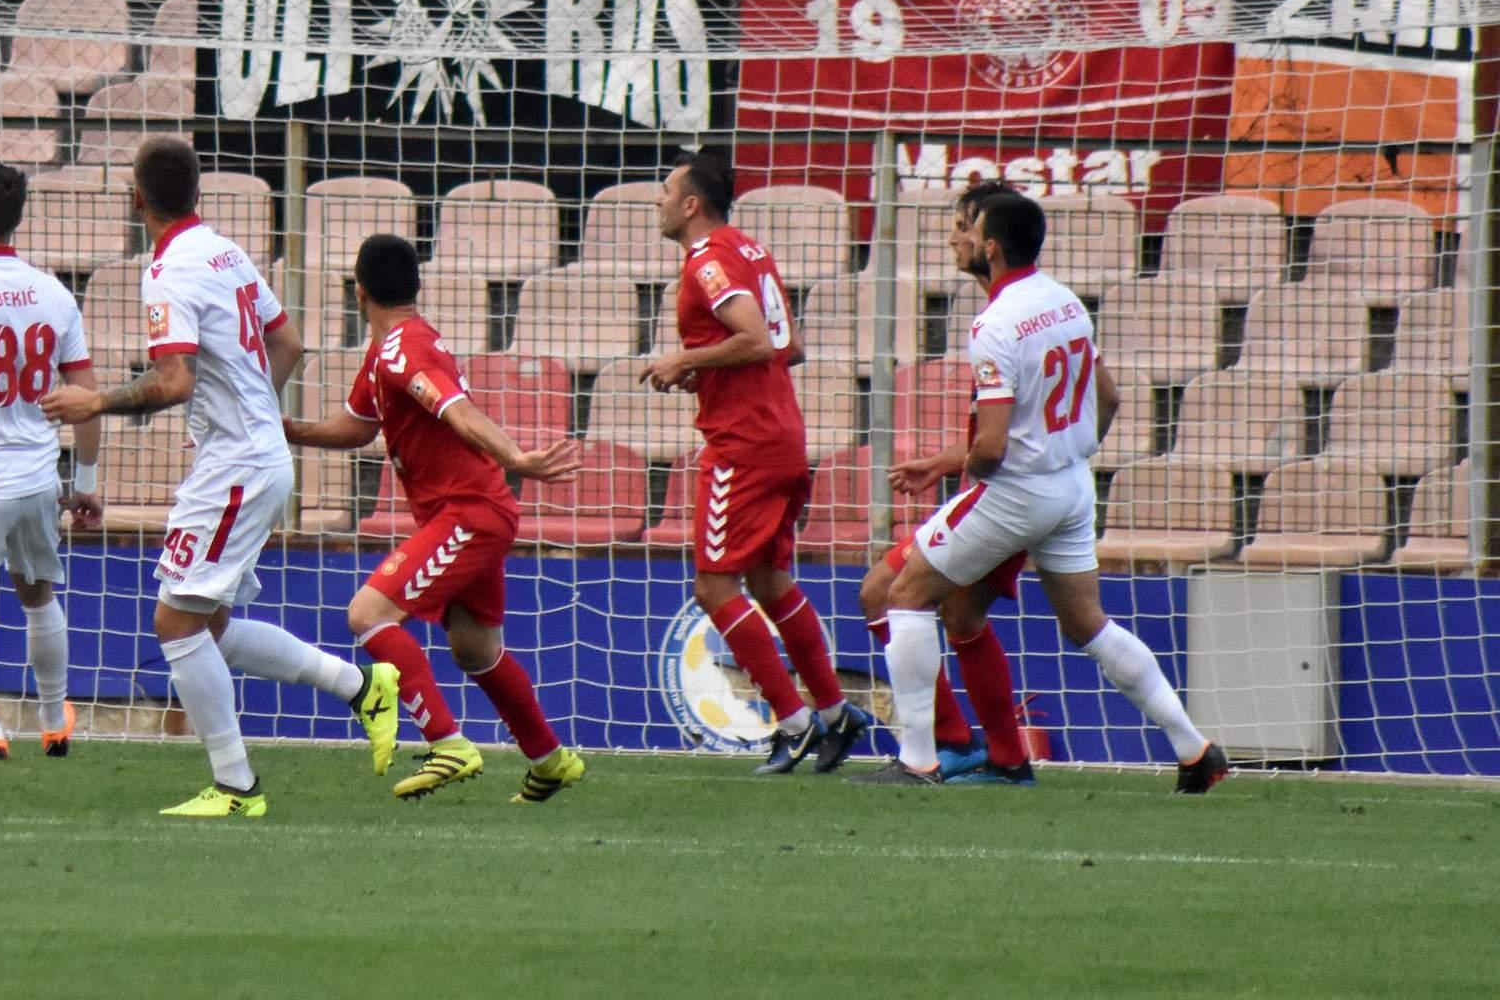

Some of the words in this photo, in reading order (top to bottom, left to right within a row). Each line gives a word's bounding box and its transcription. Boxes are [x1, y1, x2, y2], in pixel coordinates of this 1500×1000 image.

[871, 142, 1161, 200] Mostar
[1043, 336, 1093, 434] 27
[164, 527, 199, 569] 45
